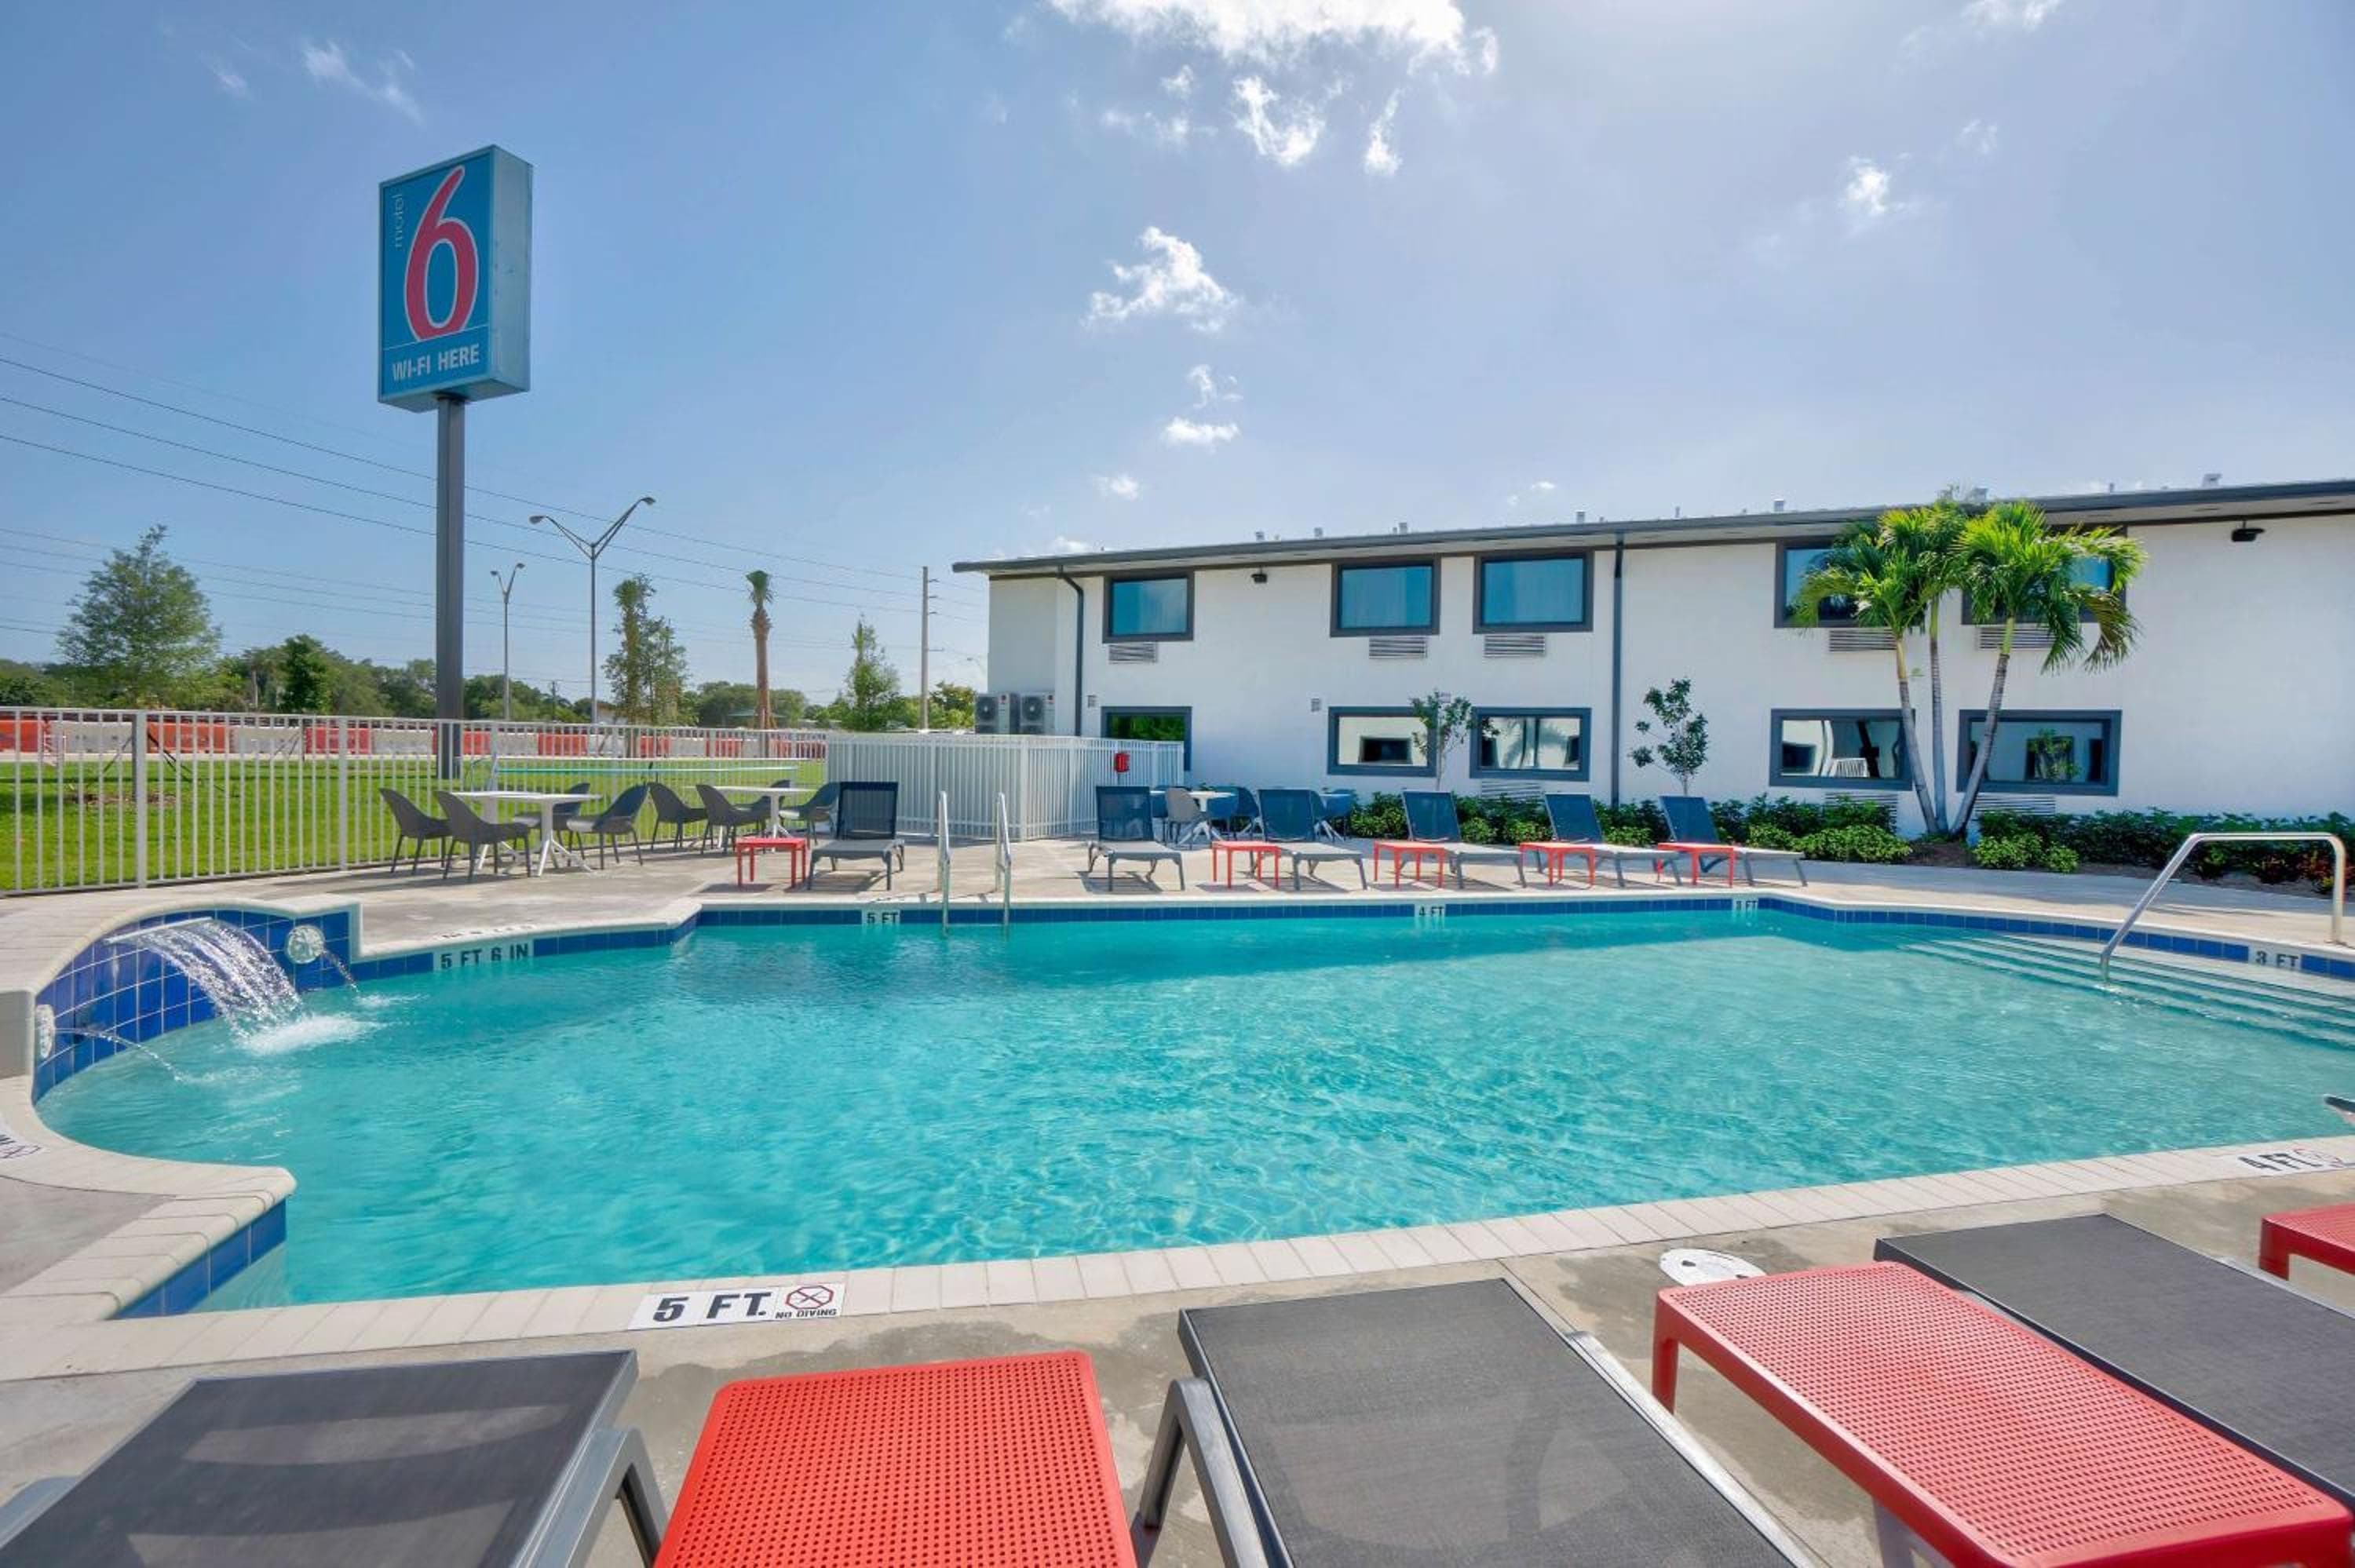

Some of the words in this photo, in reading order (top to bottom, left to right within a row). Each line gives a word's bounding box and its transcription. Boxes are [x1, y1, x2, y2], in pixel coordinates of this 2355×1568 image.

[404, 165, 480, 341] 6
[392, 355, 431, 381] WI-FI
[438, 343, 480, 371] HERE
[867, 912, 875, 923] 5
[882, 912, 898, 923] FT
[1431, 906, 1444, 917] FT
[440, 954, 452, 969] 5
[460, 950, 482, 967] FT
[510, 943, 528, 961] IN
[2276, 954, 2299, 968] FT
[653, 1296, 688, 1322] 5
[706, 1292, 772, 1319] FT.
[796, 1308, 837, 1318] DIVING
